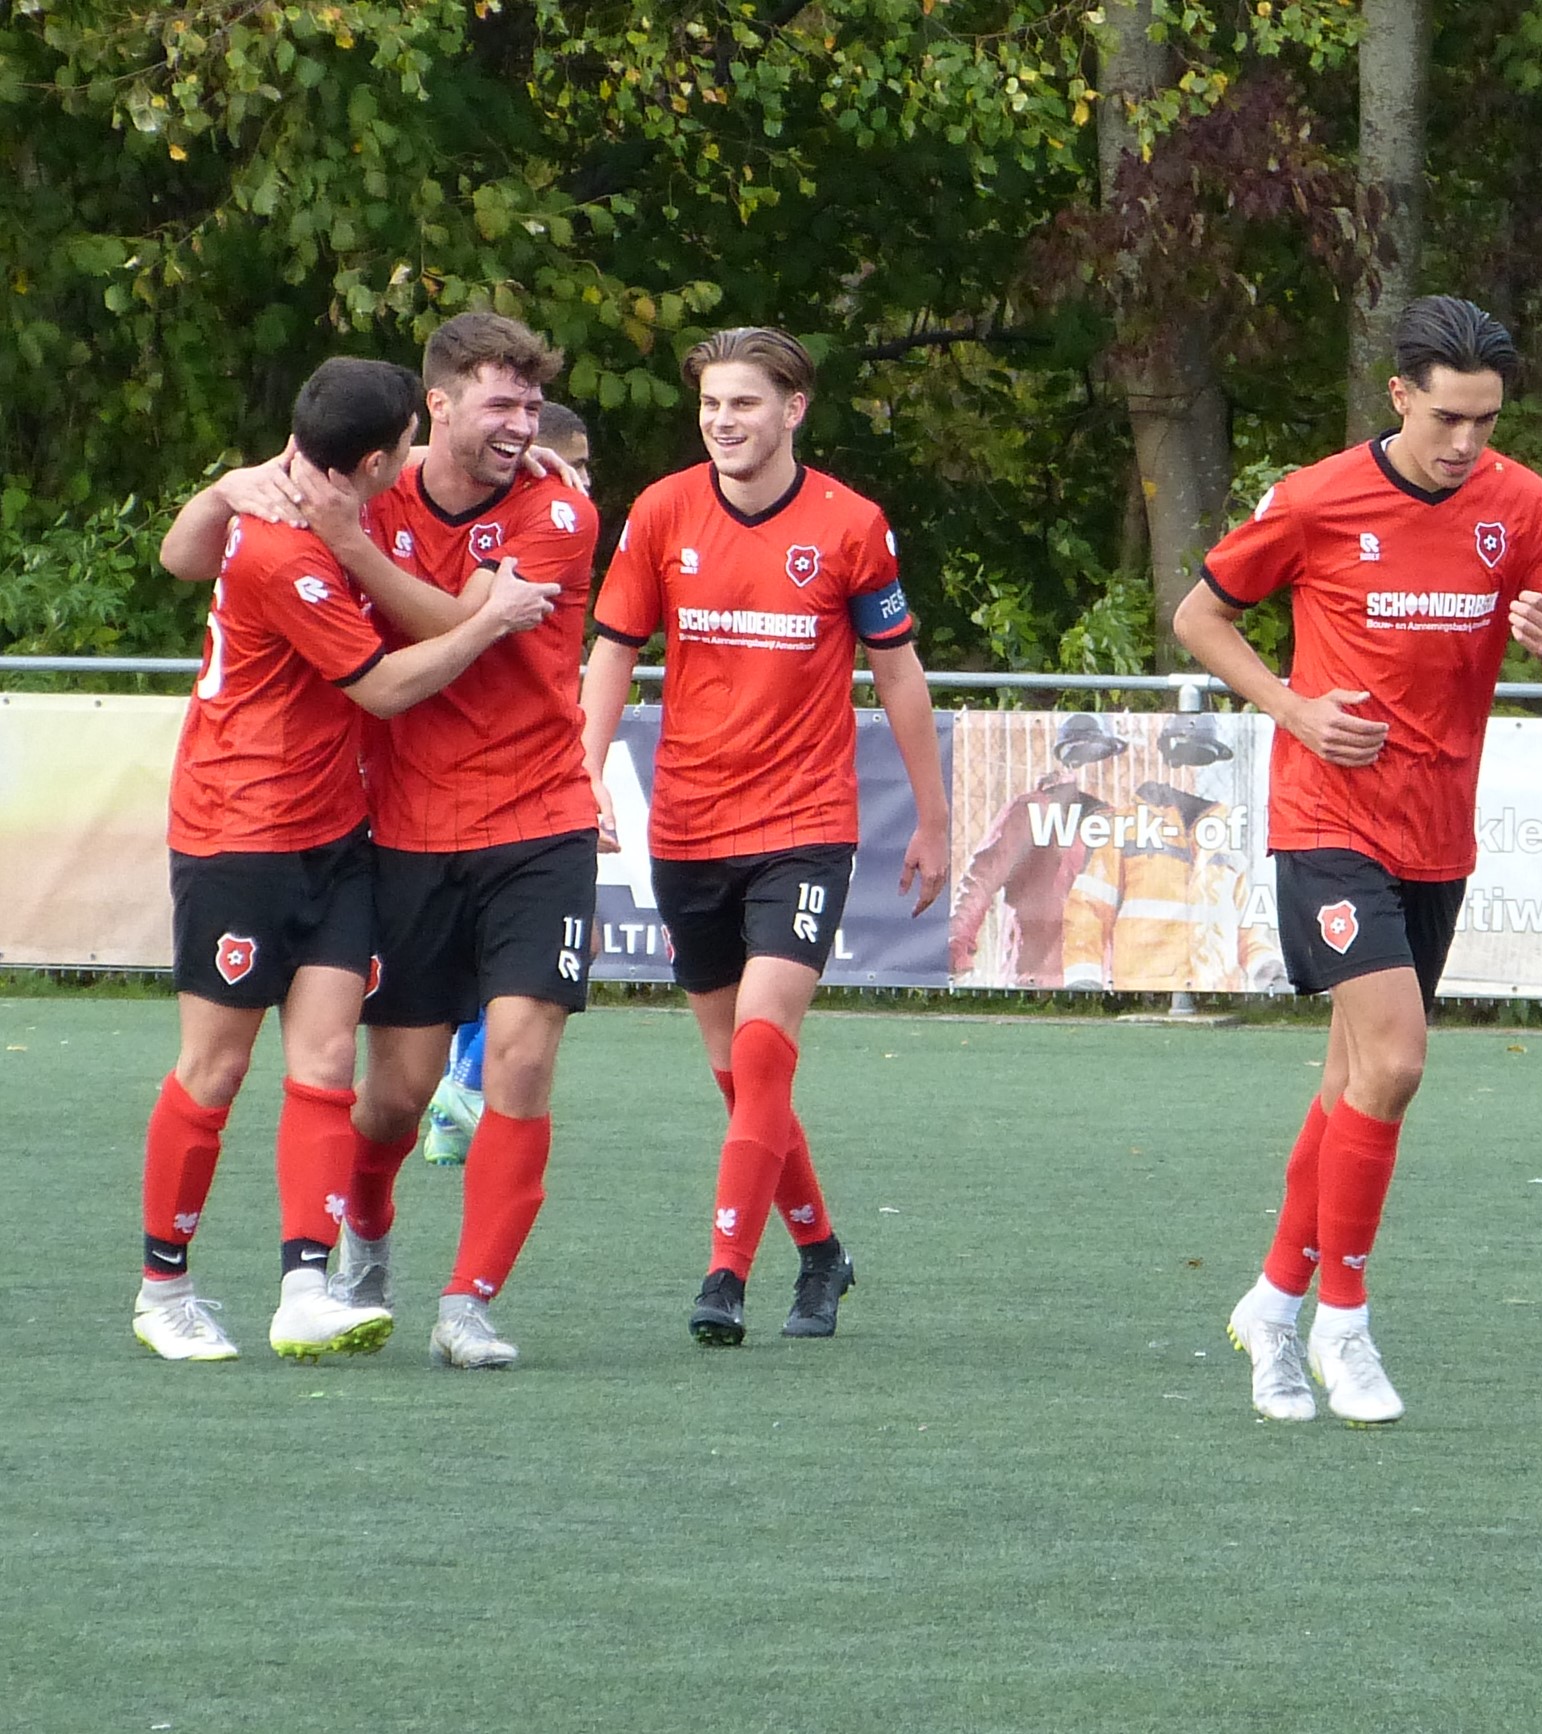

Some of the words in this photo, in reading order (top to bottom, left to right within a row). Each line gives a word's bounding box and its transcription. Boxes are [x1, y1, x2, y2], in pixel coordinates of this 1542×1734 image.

[1027, 802, 1180, 849] Werk-
[1195, 804, 1248, 850] of
[798, 882, 825, 914] 10
[563, 916, 583, 950] 11
